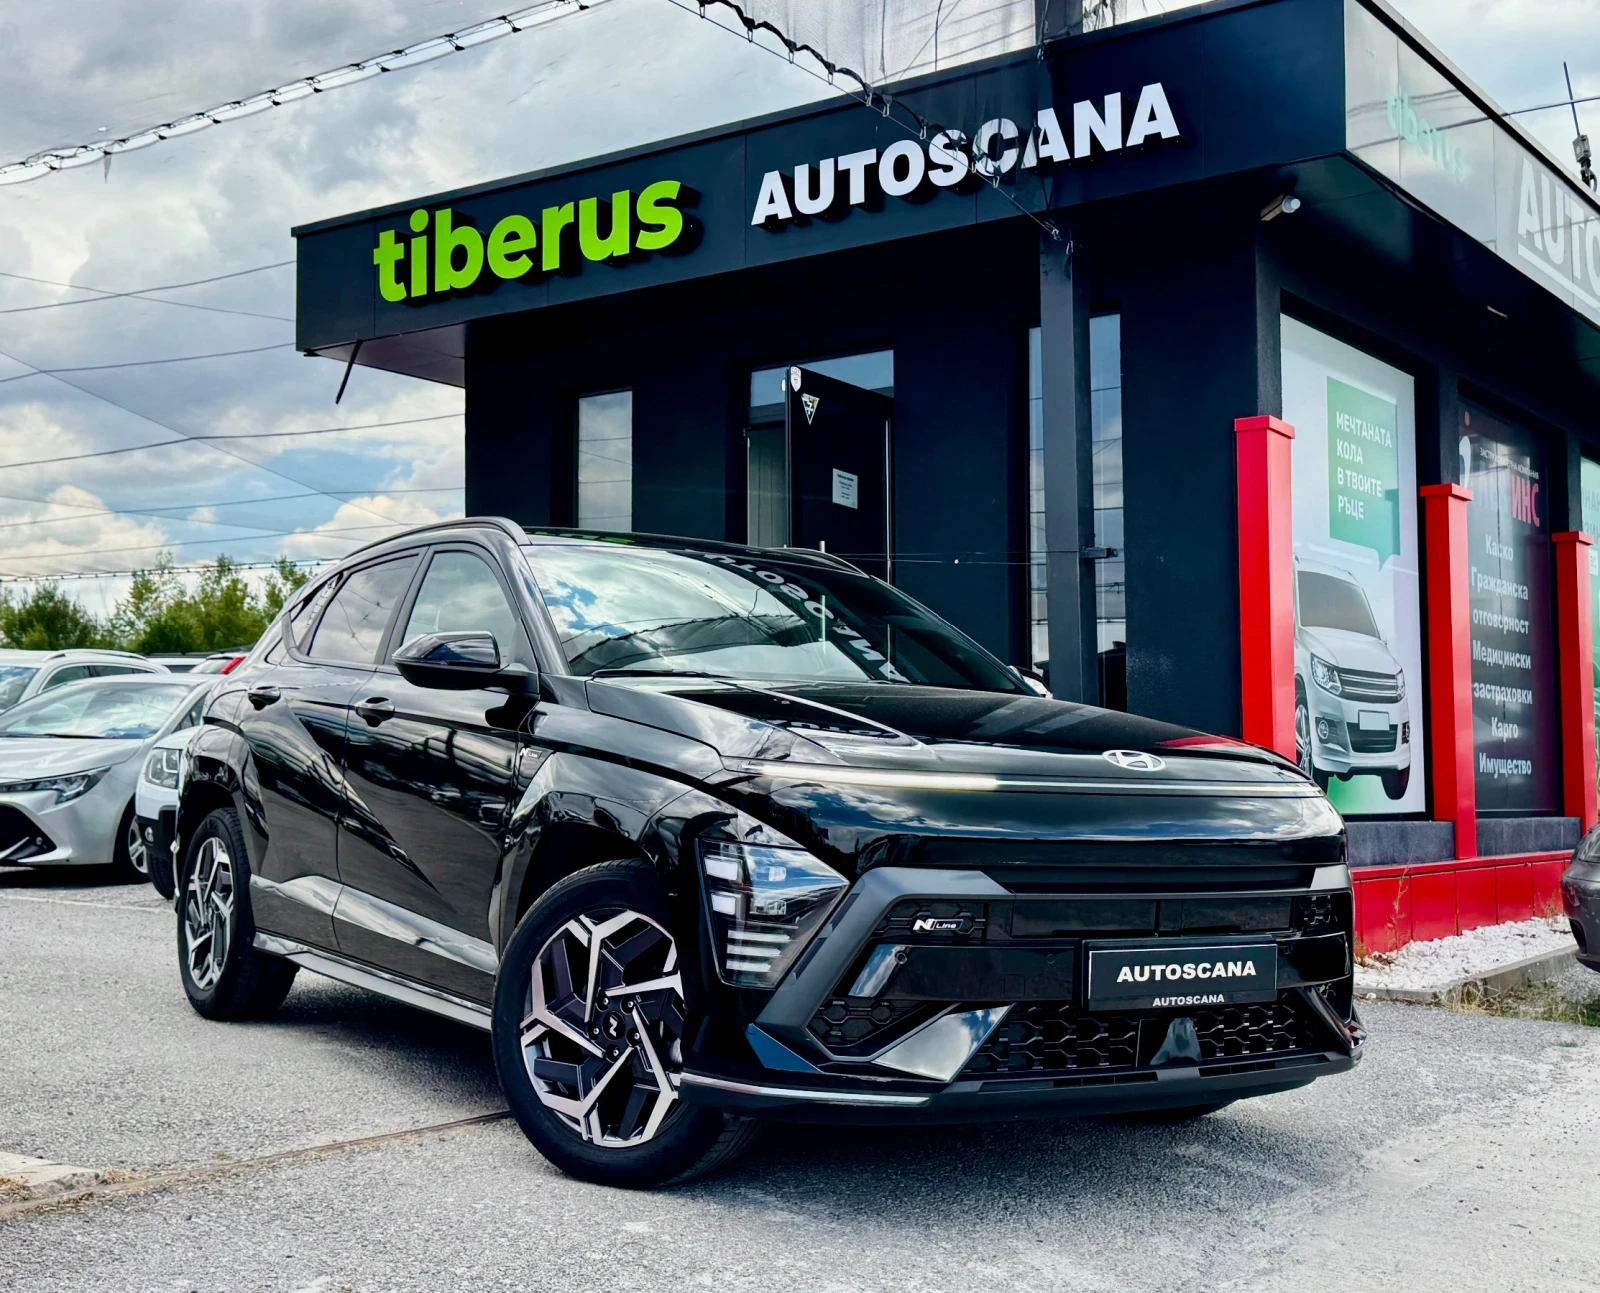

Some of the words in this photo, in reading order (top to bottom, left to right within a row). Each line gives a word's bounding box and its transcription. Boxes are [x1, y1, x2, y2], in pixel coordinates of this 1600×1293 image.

[751, 82, 1181, 226] AUTOSCANA
[373, 180, 684, 303] tiberus
[1336, 411, 1392, 448] МЕЧТАНАТА
[1336, 439, 1363, 464] КОЛА
[1337, 467, 1344, 485] В
[1345, 469, 1382, 497] ТВОИТЕ
[1337, 495, 1364, 520] РЪЦЕ
[1511, 474, 1540, 527] ИНС
[1485, 534, 1514, 560] Каско
[1471, 566, 1528, 600] Гражданска
[1473, 608, 1529, 634] отговорност
[1473, 640, 1531, 669] Медицински
[1474, 682, 1533, 705] застраховки
[1491, 716, 1519, 742] Карго
[1479, 752, 1532, 779] Имущество
[1116, 960, 1257, 983] AUTOSCANA
[1152, 993, 1225, 1007] AUTOSCANA
